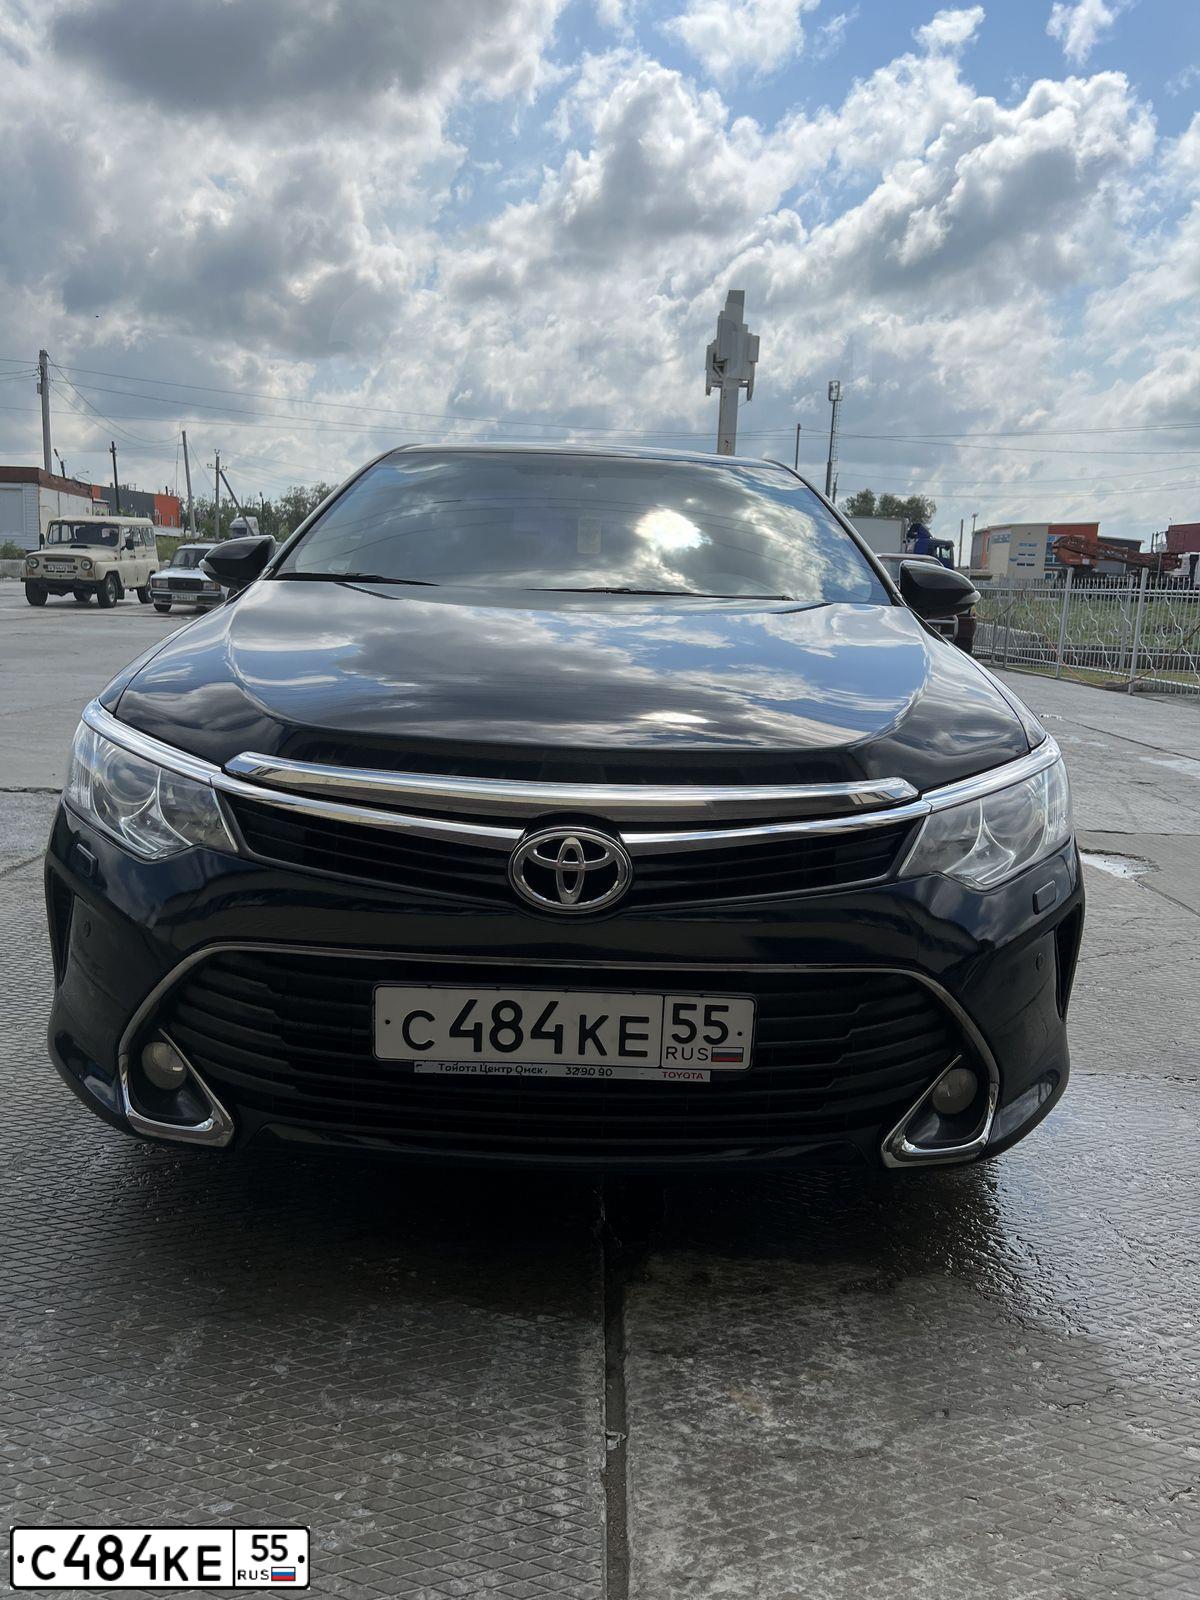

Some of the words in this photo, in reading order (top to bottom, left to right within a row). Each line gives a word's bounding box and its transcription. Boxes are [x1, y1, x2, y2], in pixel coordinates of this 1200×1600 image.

[671, 1003, 729, 1045] 55
[665, 1046, 709, 1061] RUS
[438, 1062, 477, 1072] Тойота
[479, 1063, 513, 1075] Центр
[662, 1071, 704, 1080] TOYOTA
